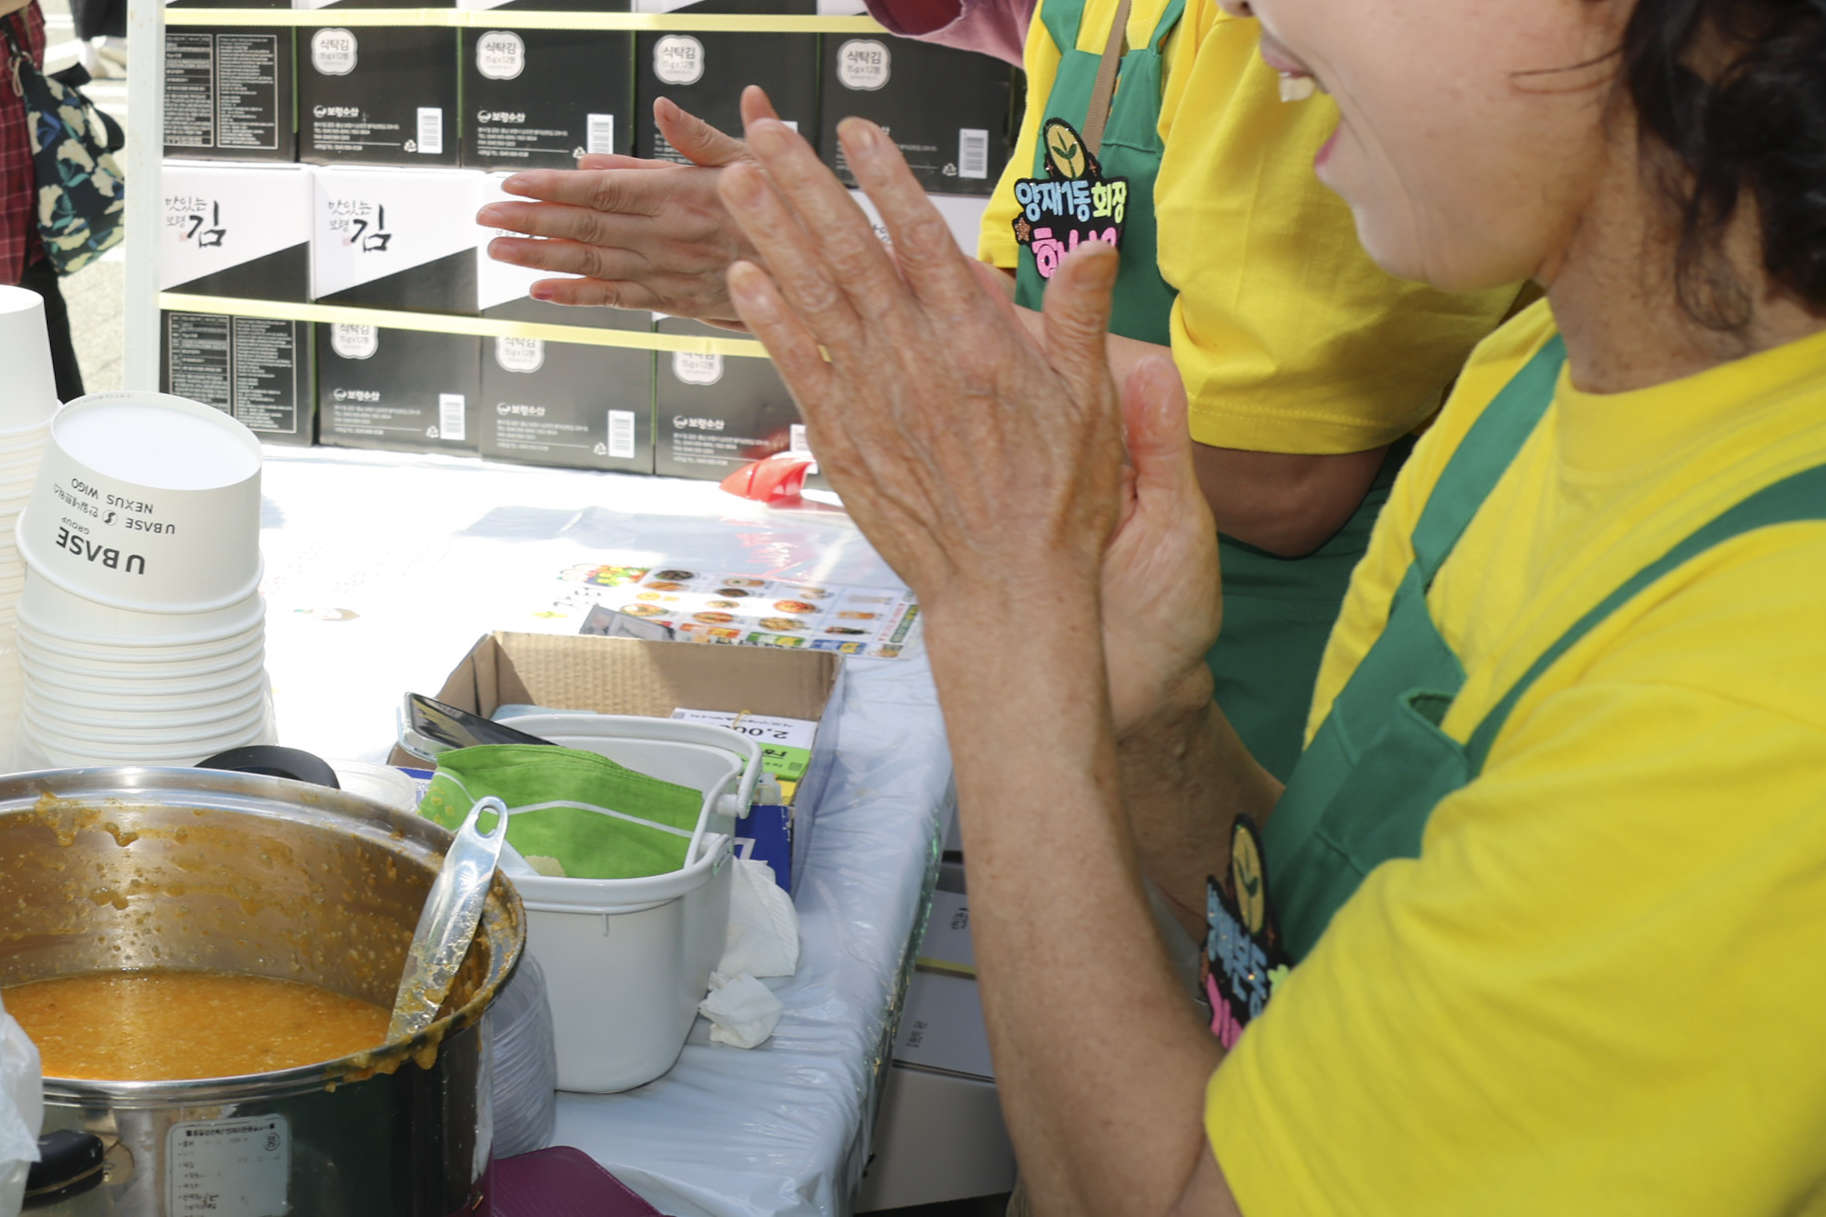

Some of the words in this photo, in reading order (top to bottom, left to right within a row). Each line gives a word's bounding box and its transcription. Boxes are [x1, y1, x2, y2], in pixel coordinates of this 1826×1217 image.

[319, 38, 350, 52] 식탁김
[485, 42, 517, 56] 식탁김
[662, 46, 696, 61] 식탁김
[846, 50, 882, 65] 식탁김
[327, 106, 360, 118] 보령수산
[492, 112, 526, 123] 보령수산
[165, 196, 208, 212] 맛있는
[328, 200, 373, 216] 맛있는
[186, 200, 227, 249] 김
[350, 204, 392, 252] 김
[347, 390, 380, 402] 보령수산
[511, 404, 545, 416] 보령수산
[688, 417, 724, 430] 보령수산
[70, 477, 99, 501] WIGO
[106, 494, 154, 515] NEXUS
[61, 516, 91, 536] GROUP
